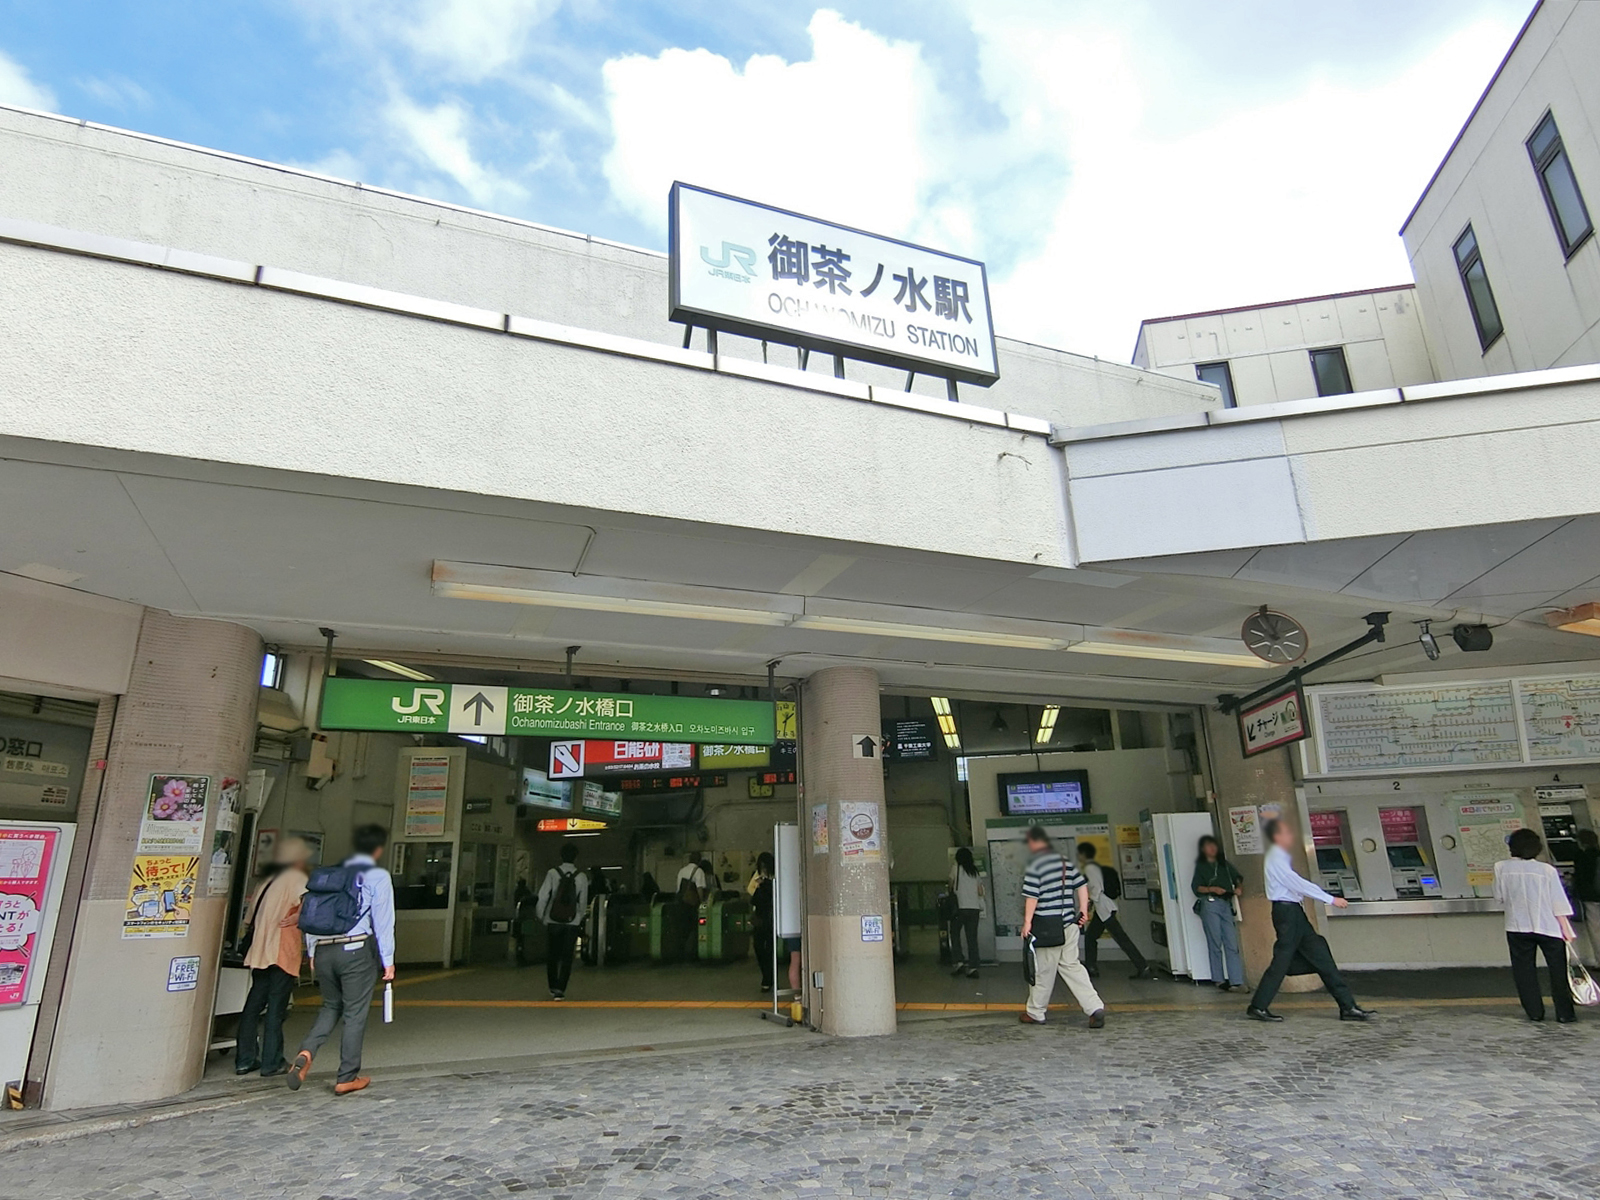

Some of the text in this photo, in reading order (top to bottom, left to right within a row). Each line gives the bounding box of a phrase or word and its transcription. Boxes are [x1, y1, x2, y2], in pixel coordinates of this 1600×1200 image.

[699, 241, 757, 277] JR
[767, 232, 973, 324] 御茶ノ水駅
[768, 292, 978, 357] OCHOMIZU STATION
[392, 687, 445, 715] JR
[513, 693, 633, 718] 御茶ノ水橋口
[397, 715, 436, 725] JR東日本
[511, 716, 625, 731] Ochanomizubashi Entrance
[1257, 711, 1279, 732] チャージ
[631, 722, 683, 733] 御茶之水桥入口
[741, 726, 756, 736] 입구
[614, 741, 660, 759] 日能研
[1553, 774, 1560, 782] 4
[1317, 785, 1322, 793] 1
[1392, 781, 1401, 790] 2
[538, 820, 545, 830] 4
[147, 858, 172, 866] ちょっと
[175, 963, 195, 973] FREE
[175, 972, 194, 982] Wi-Fi
